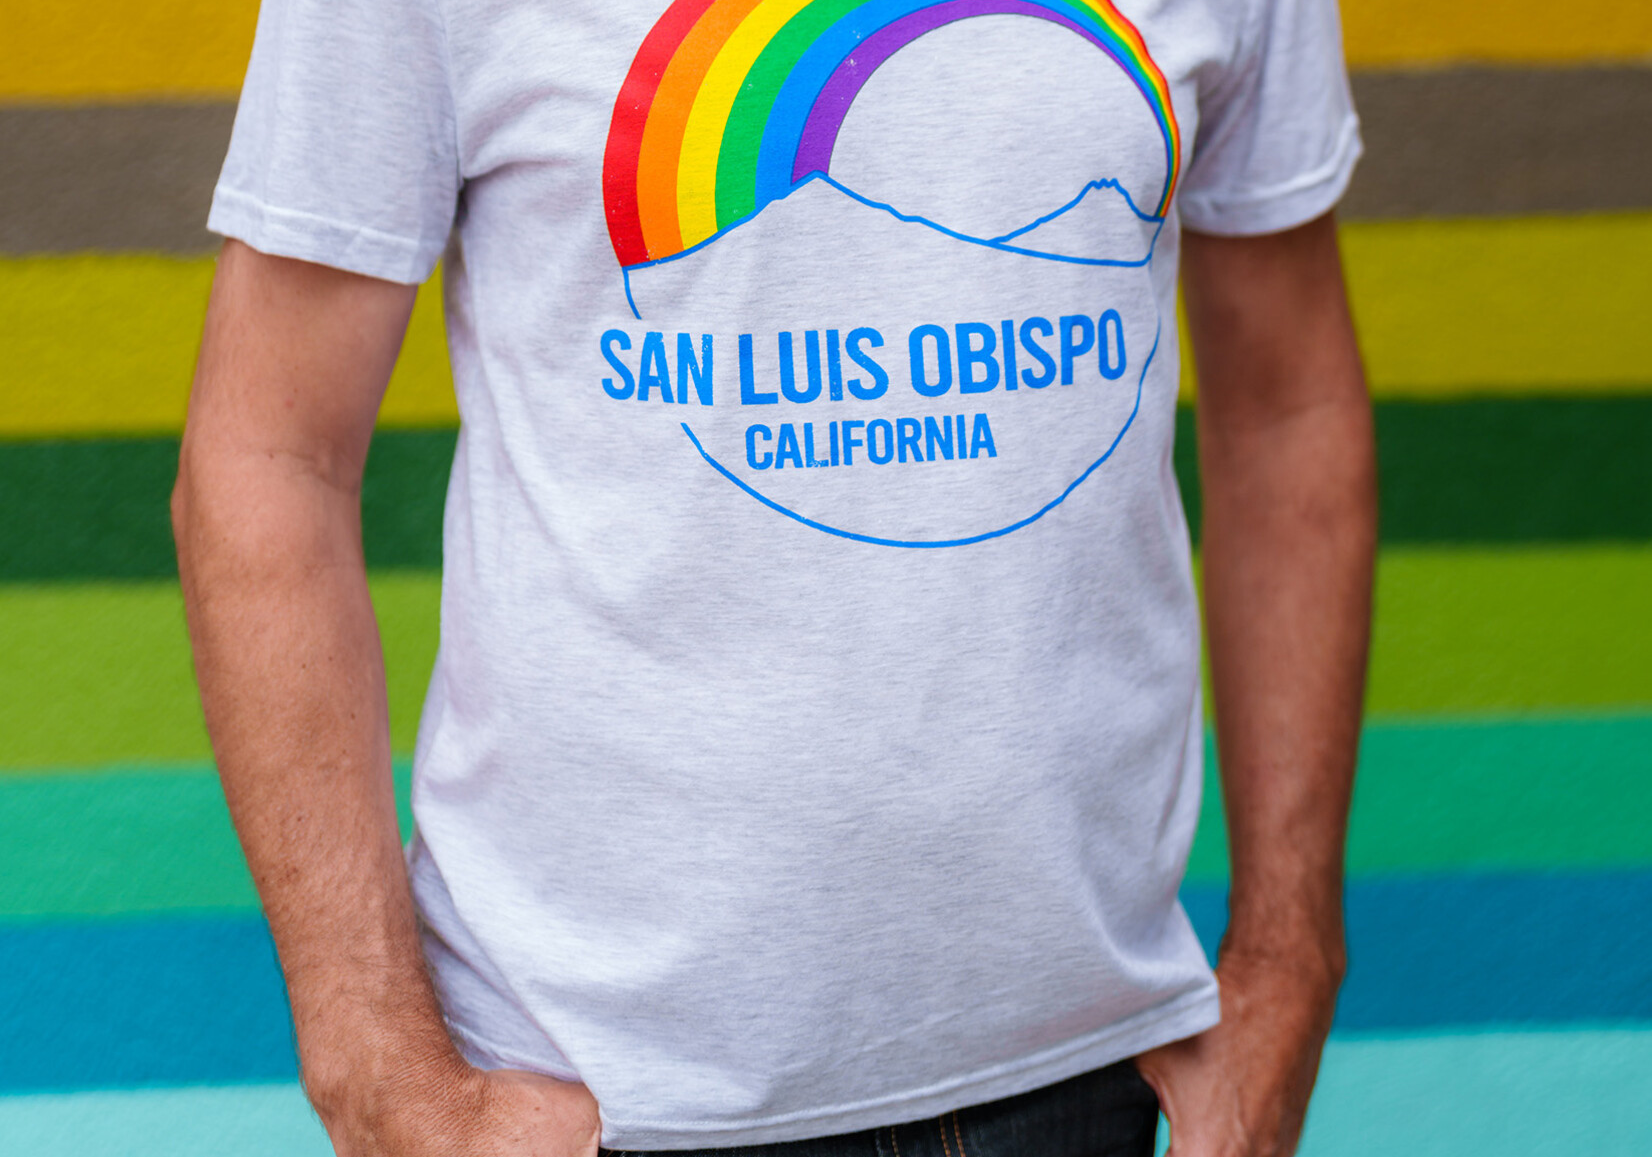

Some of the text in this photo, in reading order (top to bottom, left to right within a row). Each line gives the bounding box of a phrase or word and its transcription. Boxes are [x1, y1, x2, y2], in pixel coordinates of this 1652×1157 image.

[600, 309, 1128, 406] SAN LUIS OBISPO
[744, 413, 998, 471] CALIFORNIA
